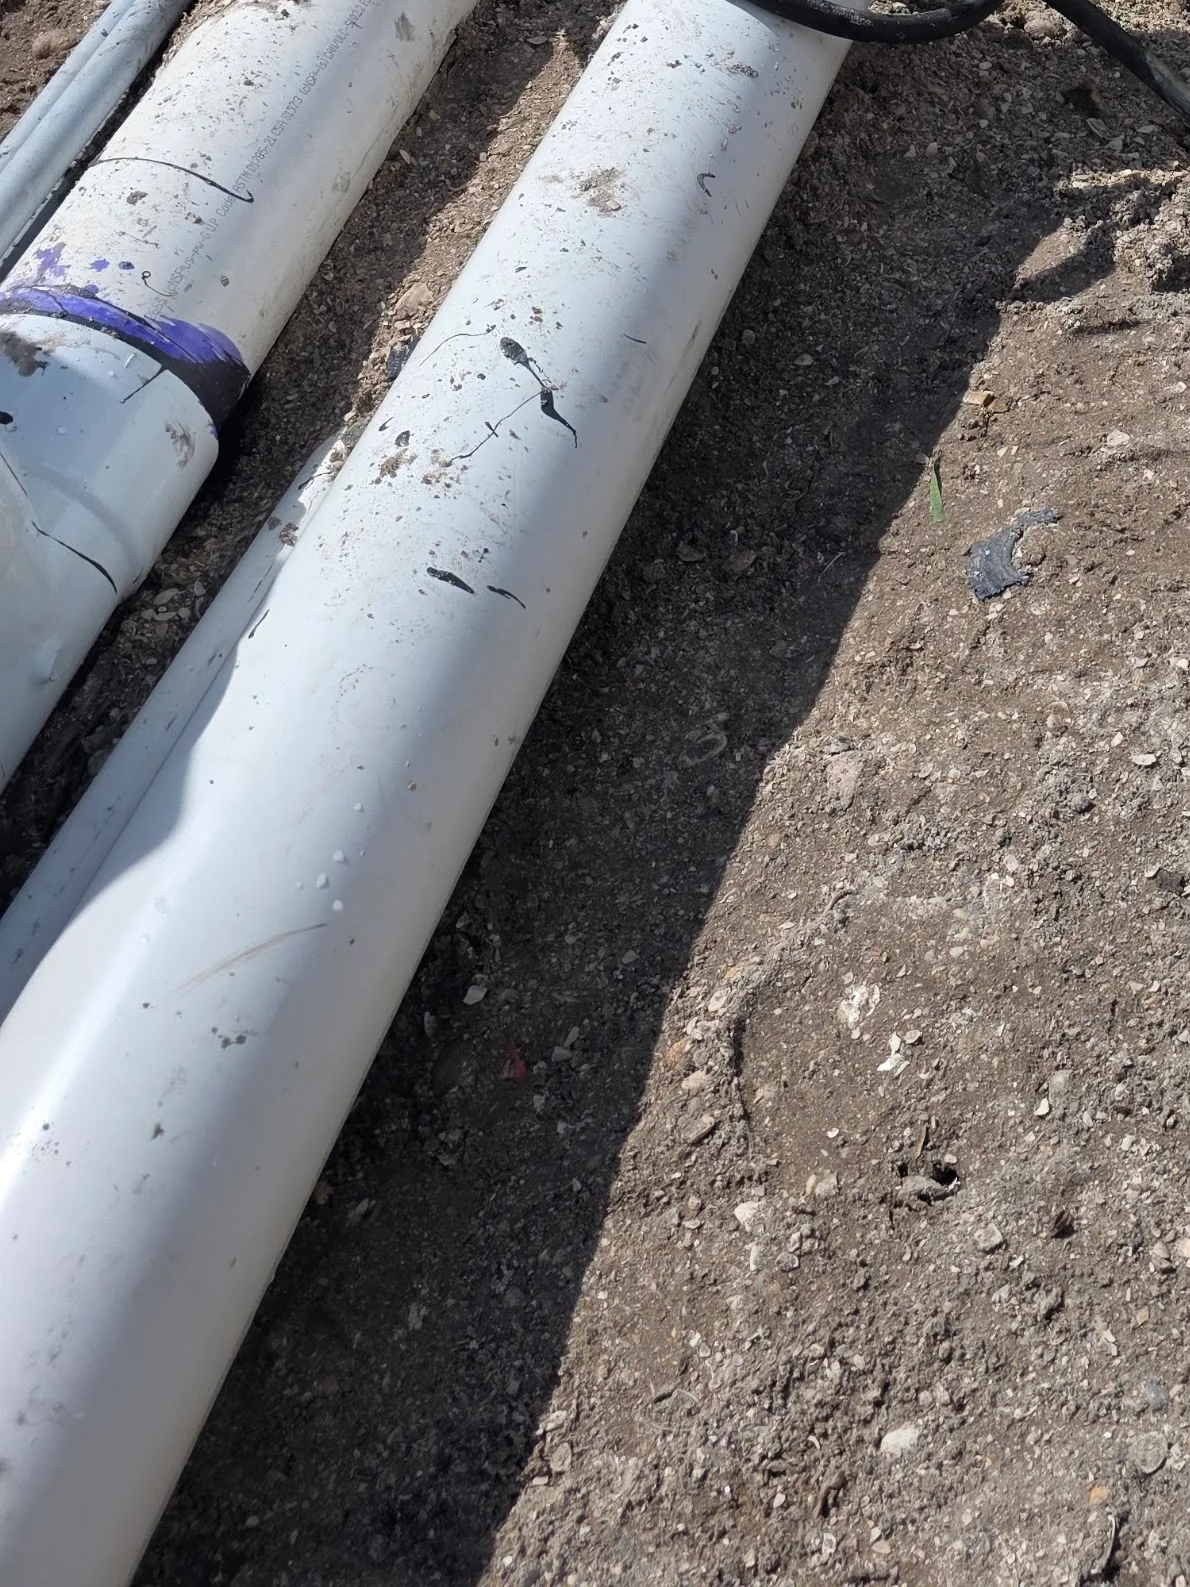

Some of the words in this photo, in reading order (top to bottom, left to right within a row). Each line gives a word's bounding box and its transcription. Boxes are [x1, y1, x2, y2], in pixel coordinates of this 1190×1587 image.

[231, 169, 253, 193] ASTM
[245, 133, 277, 173] D1785-21
[269, 118, 288, 137] CSA
